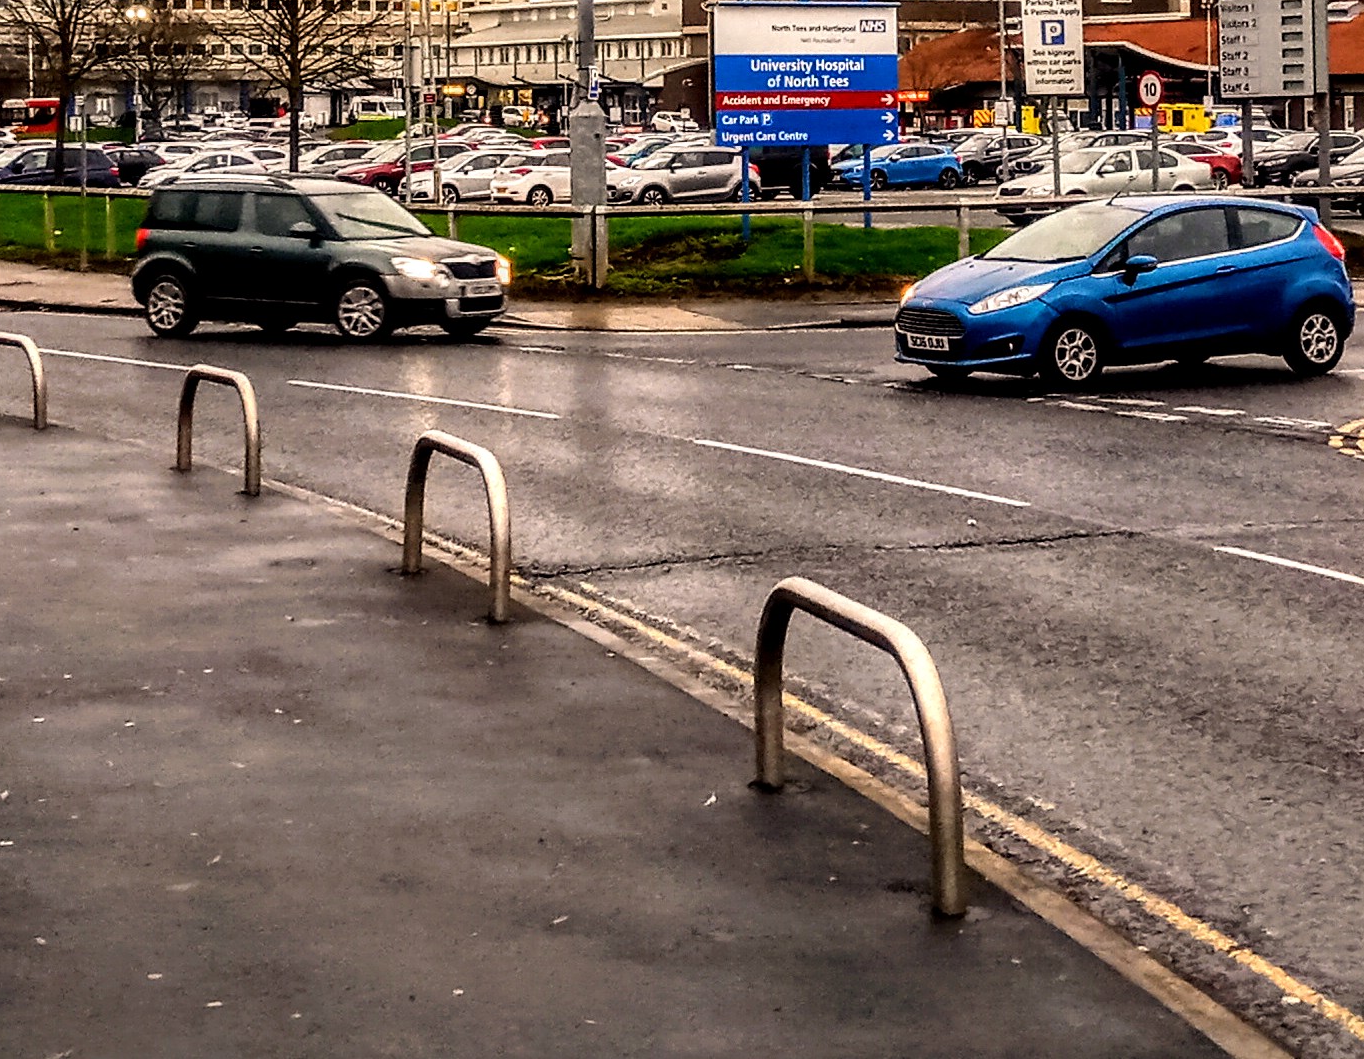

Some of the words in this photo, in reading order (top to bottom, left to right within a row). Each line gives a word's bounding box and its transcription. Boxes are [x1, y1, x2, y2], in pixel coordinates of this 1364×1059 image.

[1025, 0, 1053, 7] Parking
[1220, 3, 1249, 13] Visitors
[1060, 8, 1080, 16] Apply
[861, 20, 885, 32] NHS
[1221, 20, 1249, 29] Visitors
[1250, 18, 1257, 28] 2
[771, 25, 791, 33] North
[792, 25, 807, 33] Tees
[809, 25, 821, 33] and
[822, 25, 856, 34] Hartlepool
[1221, 35, 1241, 45] Staff
[1032, 49, 1046, 57] See
[1047, 50, 1075, 58] signage
[1221, 51, 1241, 61] Staff
[1242, 51, 1248, 60] 2
[750, 59, 812, 75] University
[815, 58, 865, 74] Hospital
[1062, 59, 1082, 67] parks
[1036, 68, 1046, 76] for
[1048, 68, 1072, 76] further
[1222, 67, 1242, 77] Staff
[1243, 67, 1249, 76] 3
[767, 75, 782, 88] of
[784, 75, 820, 88] North
[821, 75, 850, 88] Tees
[1144, 82, 1157, 97] 10
[1222, 83, 1242, 93] Staff
[1243, 83, 1250, 92] 4
[722, 95, 761, 106] Accident
[763, 95, 780, 106] and
[782, 95, 831, 108] Emergency
[721, 115, 737, 125] Car
[739, 114, 759, 125] Park
[721, 132, 754, 144] Urgent
[755, 131, 777, 142] Care
[778, 131, 808, 142] Centre
